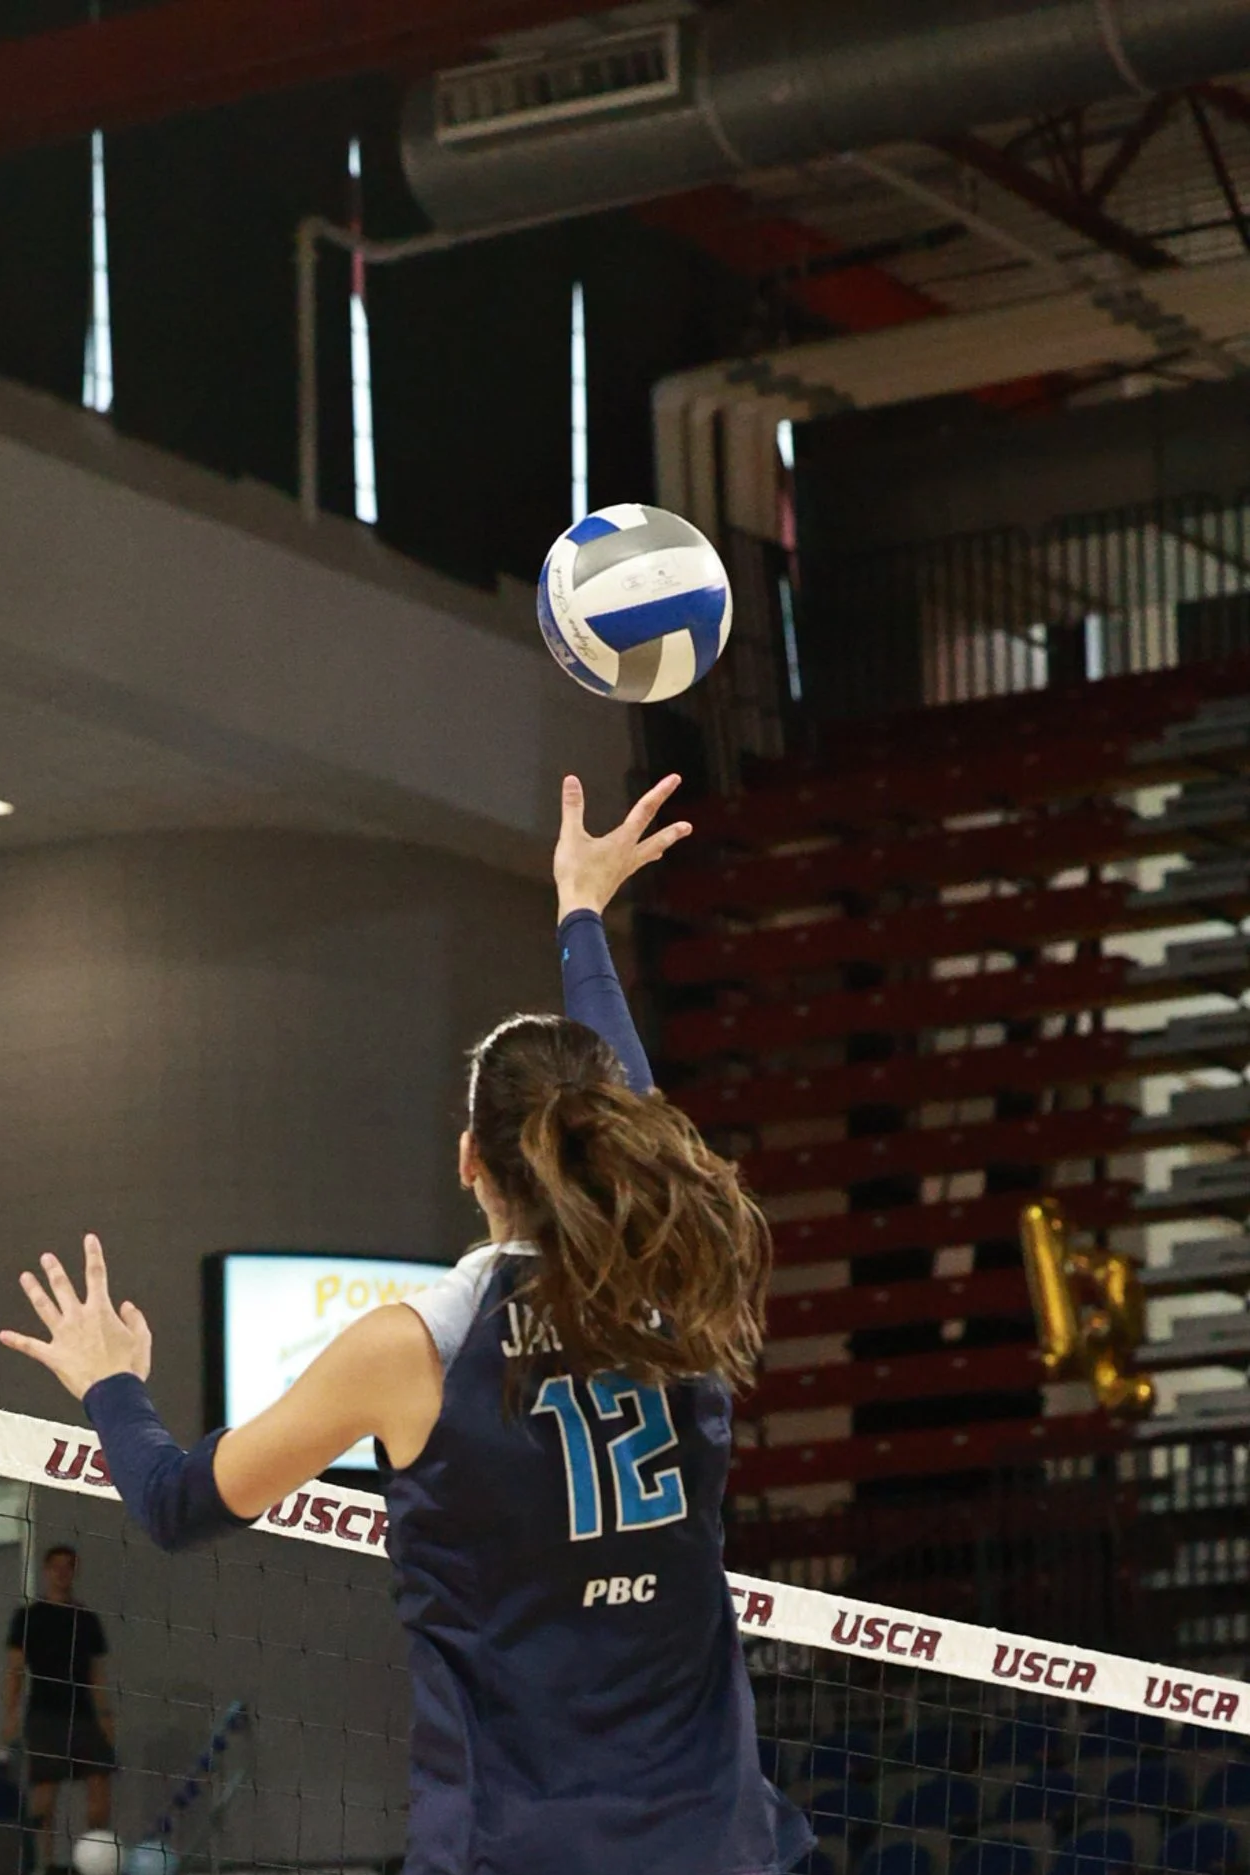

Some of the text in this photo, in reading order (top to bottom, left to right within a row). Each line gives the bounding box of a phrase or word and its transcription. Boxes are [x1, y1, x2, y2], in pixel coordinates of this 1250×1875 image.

[45, 1437, 114, 1487] US
[530, 1363, 687, 1542] 12
[582, 1573, 657, 1608] PBC
[830, 1611, 944, 1662] USCA
[991, 1645, 1099, 1694] USCA
[1143, 1676, 1241, 1723] USCA
